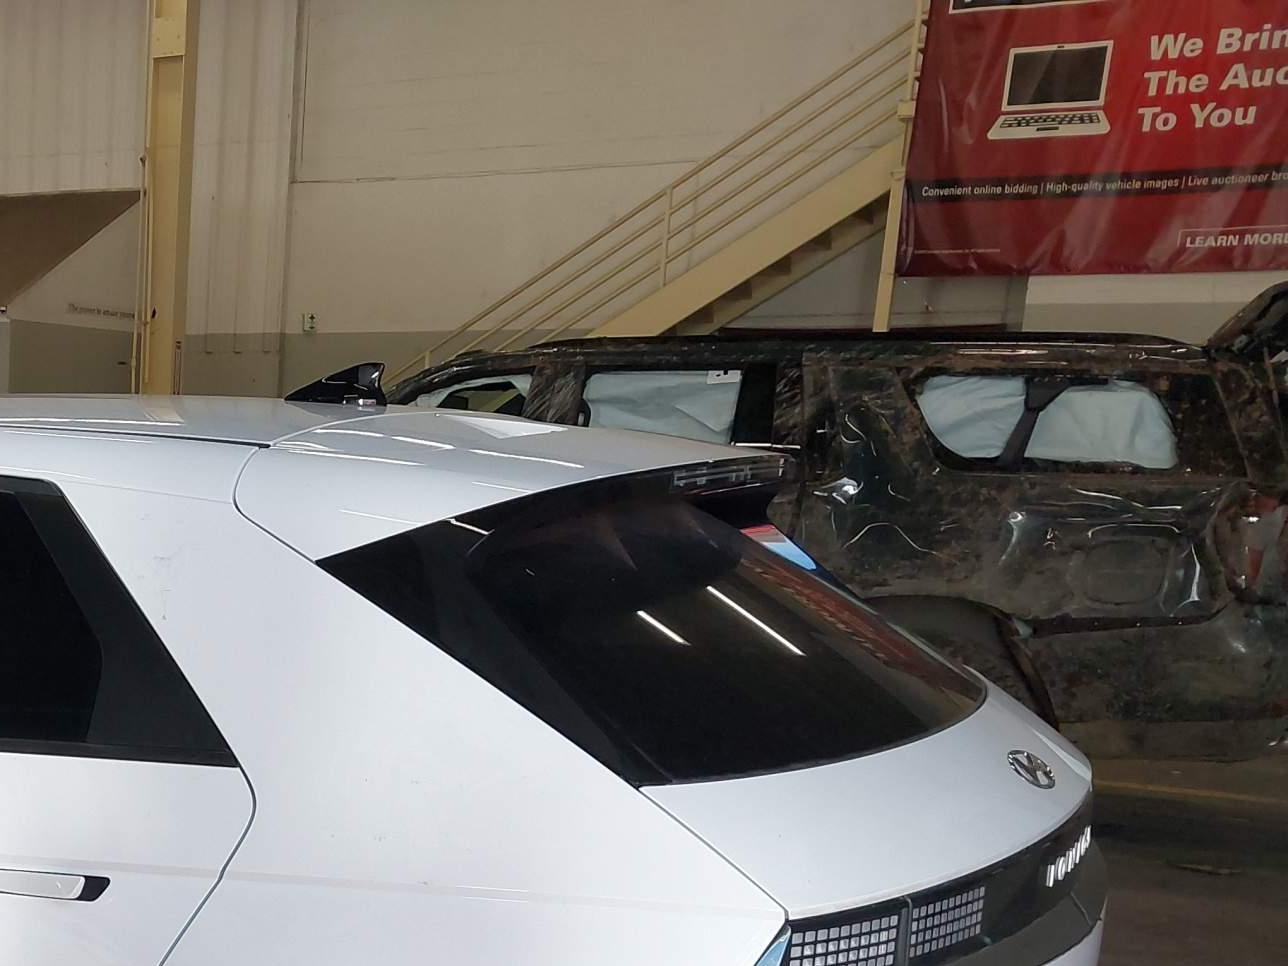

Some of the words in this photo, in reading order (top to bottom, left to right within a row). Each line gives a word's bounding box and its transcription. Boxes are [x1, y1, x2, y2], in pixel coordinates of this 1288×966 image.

[1150, 33, 1204, 61] We
[1143, 70, 1209, 97] The
[1137, 106, 1177, 132] To
[1190, 102, 1257, 129] You
[922, 185, 972, 197] Convenient
[974, 184, 1002, 195] online
[1004, 183, 1038, 195] bidding
[1046, 180, 1103, 194] High-quality
[1106, 178, 1141, 191] vehicle
[1143, 177, 1179, 190] images
[1187, 175, 1209, 187] Live
[1211, 173, 1268, 185] auctioneer
[1186, 235, 1239, 248] LEARN
